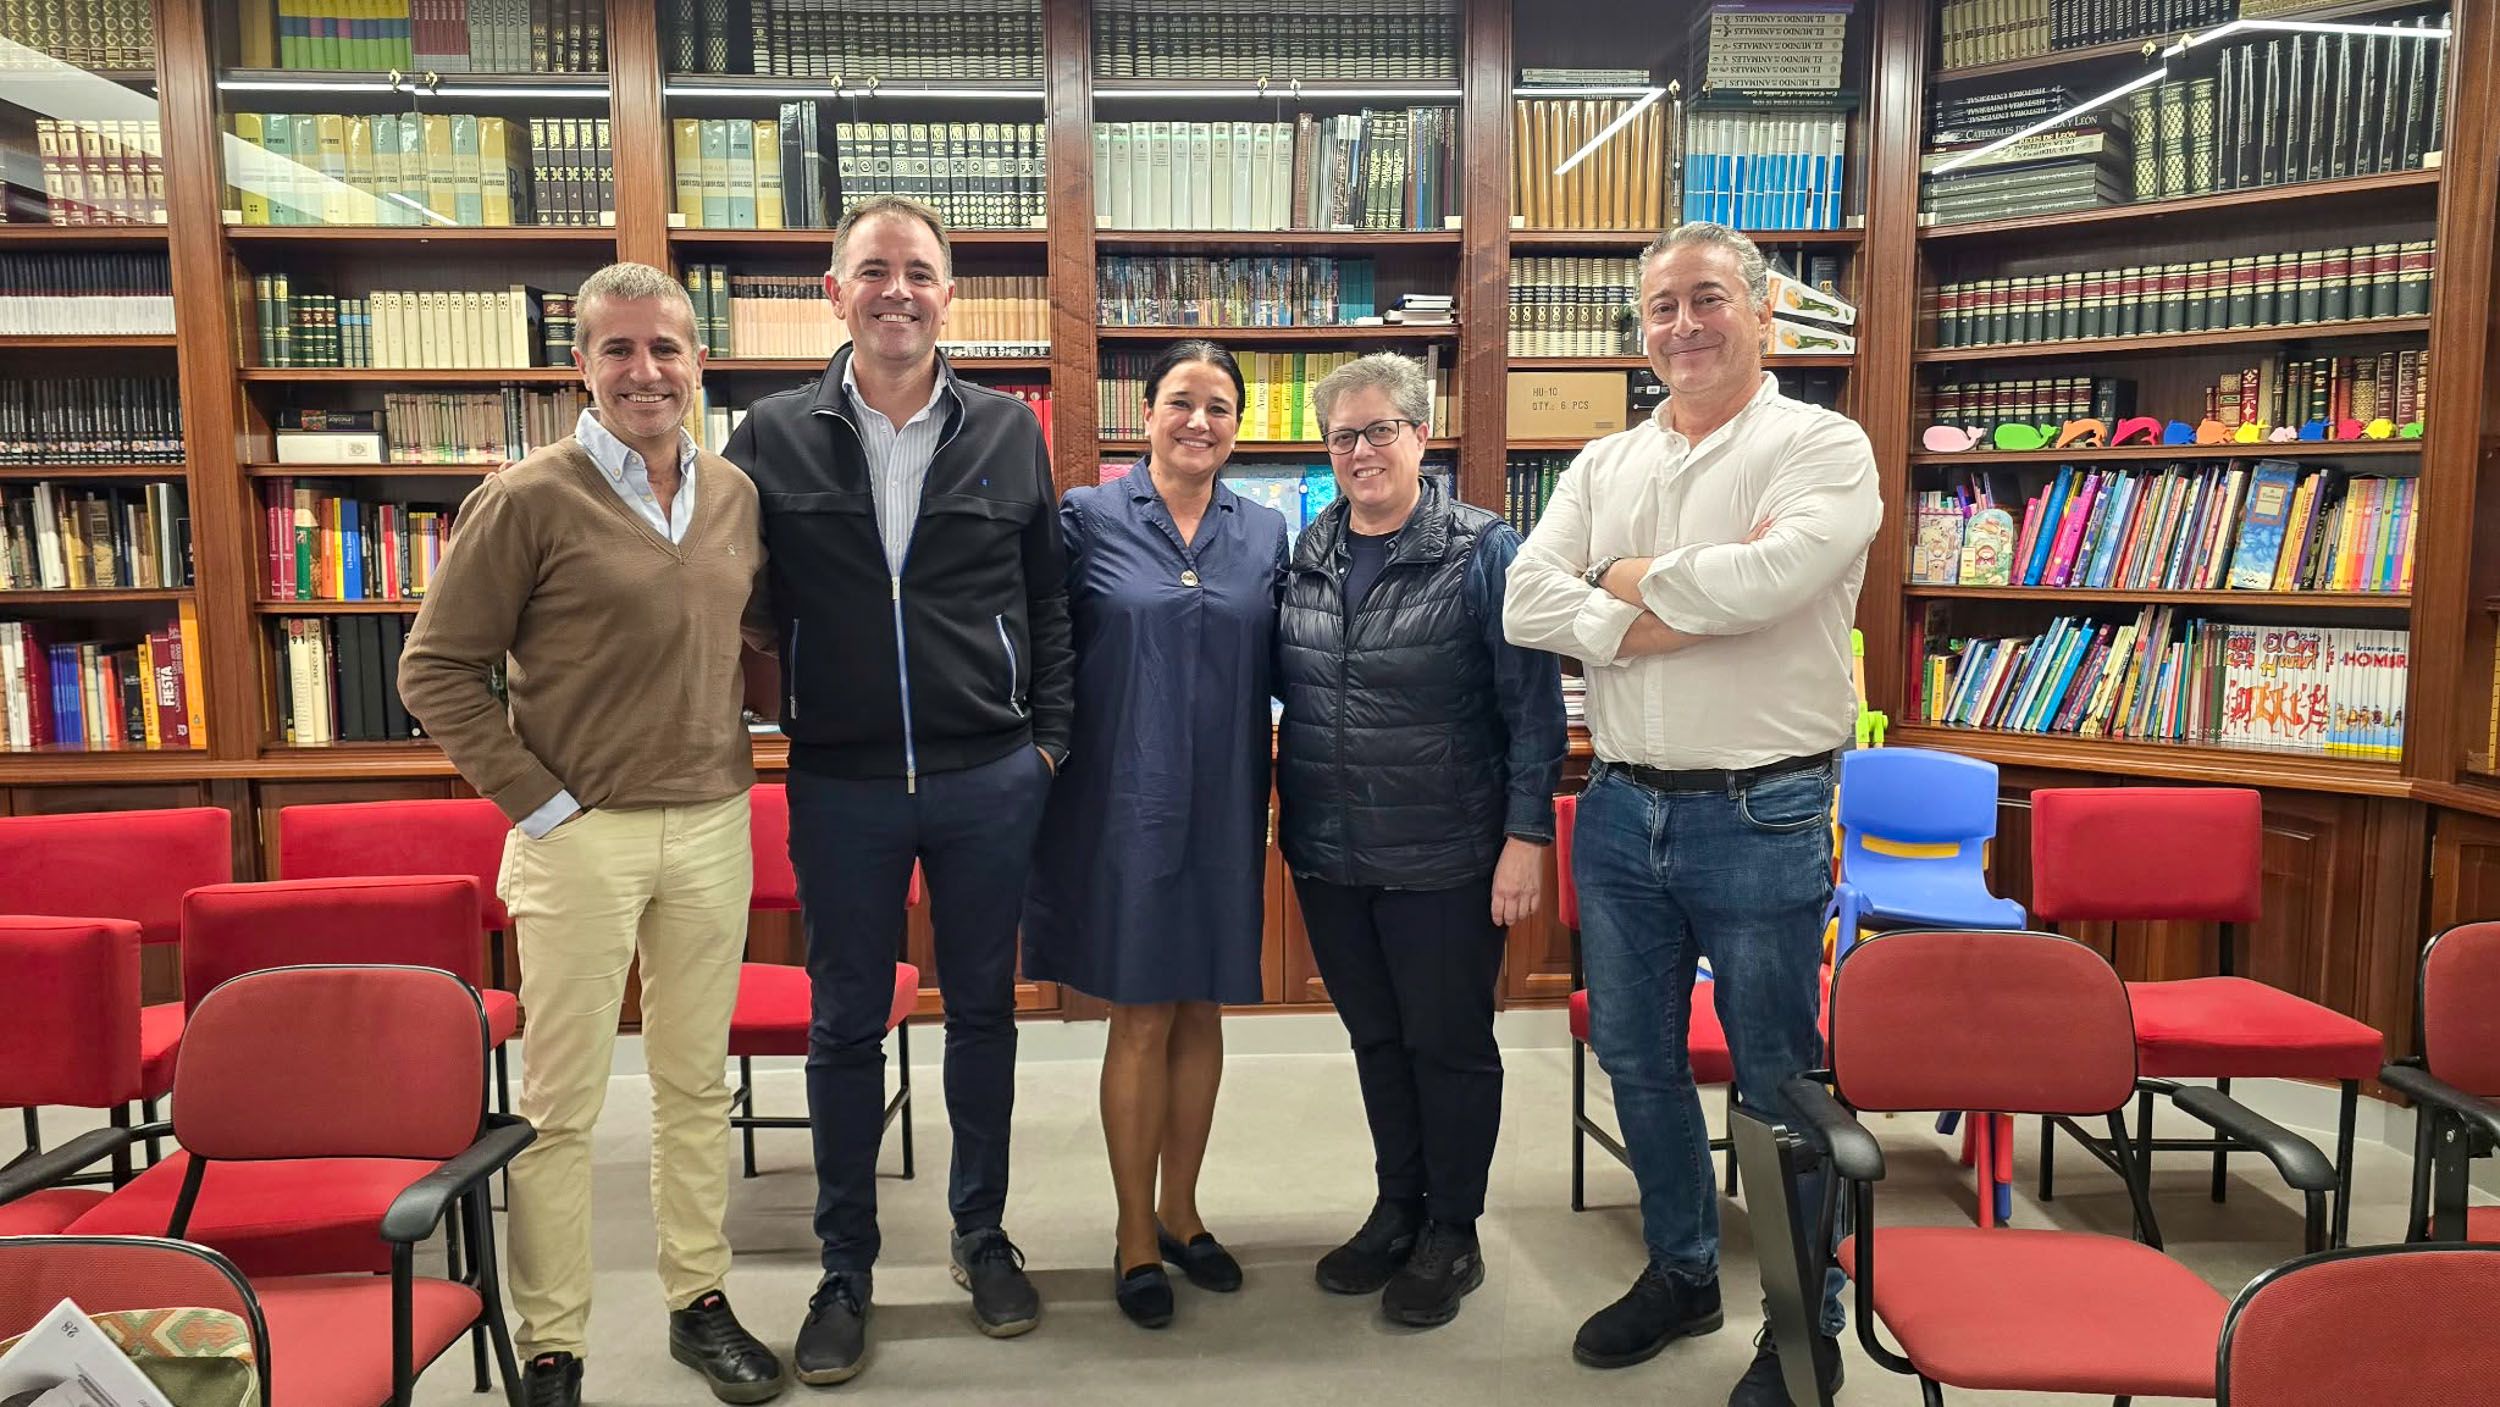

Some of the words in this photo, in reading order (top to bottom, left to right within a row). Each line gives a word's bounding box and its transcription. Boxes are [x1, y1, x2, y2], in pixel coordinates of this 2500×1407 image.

[2116, 0, 2124, 30] HISTOR
[1965, 125, 2014, 140] CATEDRALES
[2074, 114, 2098, 126] LEÓN
[1532, 387, 1558, 397] HU-10
[1560, 401, 1566, 410] 6
[1572, 401, 1589, 410] PCS
[161, 666, 175, 706] FIESTA
[61, 1320, 80, 1338] 28
